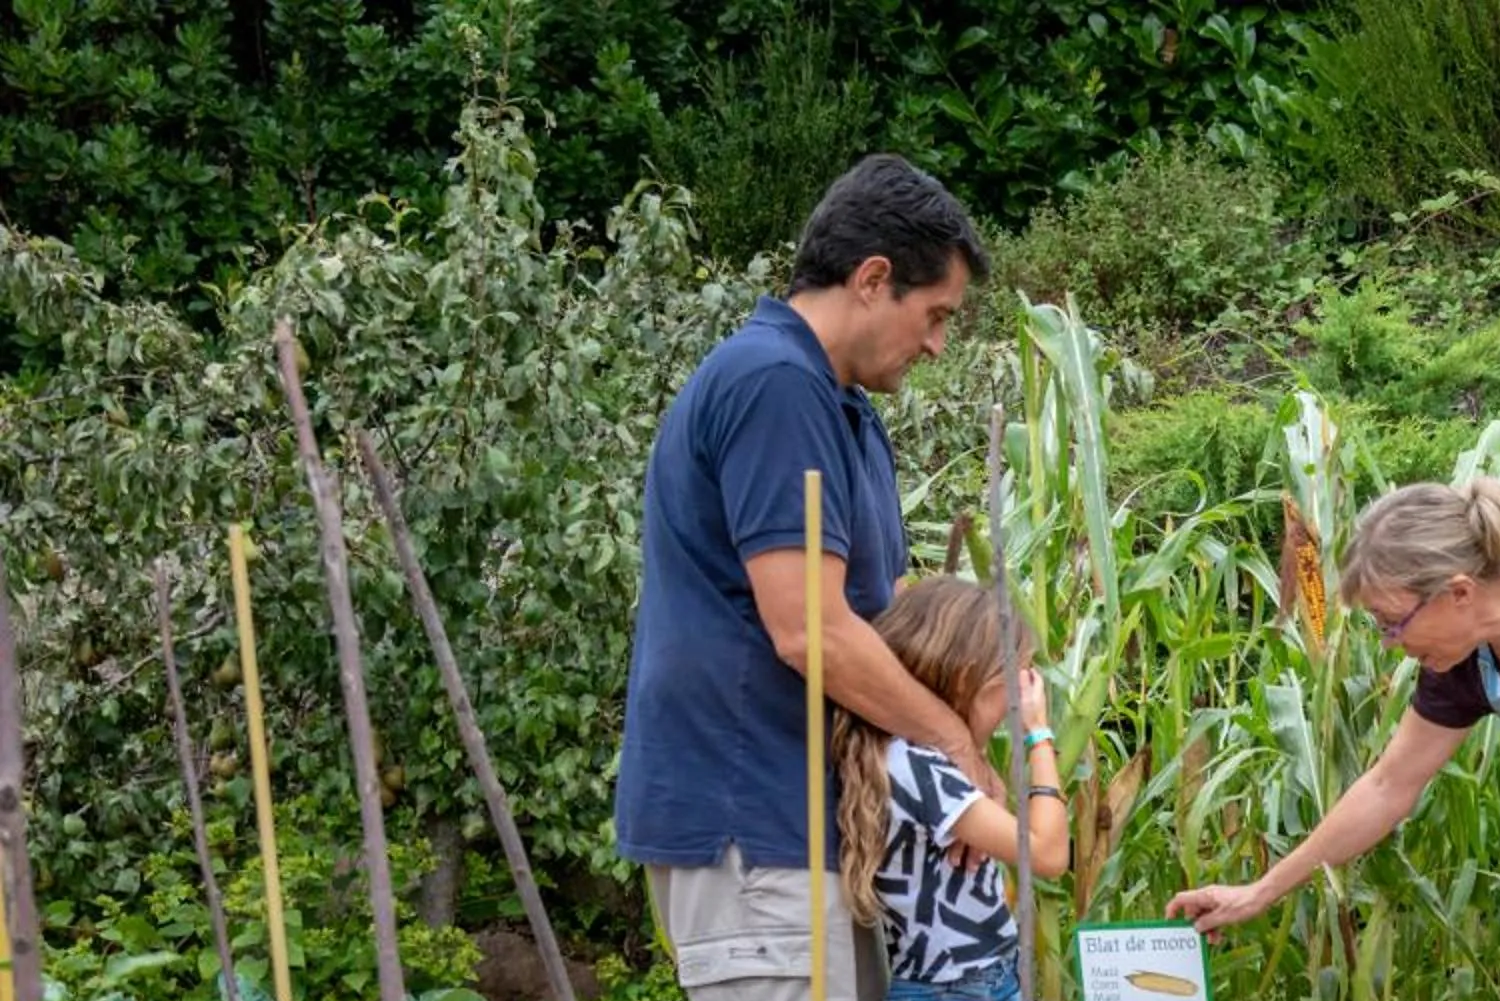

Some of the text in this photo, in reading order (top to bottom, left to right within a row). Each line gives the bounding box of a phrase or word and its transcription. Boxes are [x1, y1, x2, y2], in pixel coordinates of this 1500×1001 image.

[1086, 935, 1197, 953] Blat de moro
